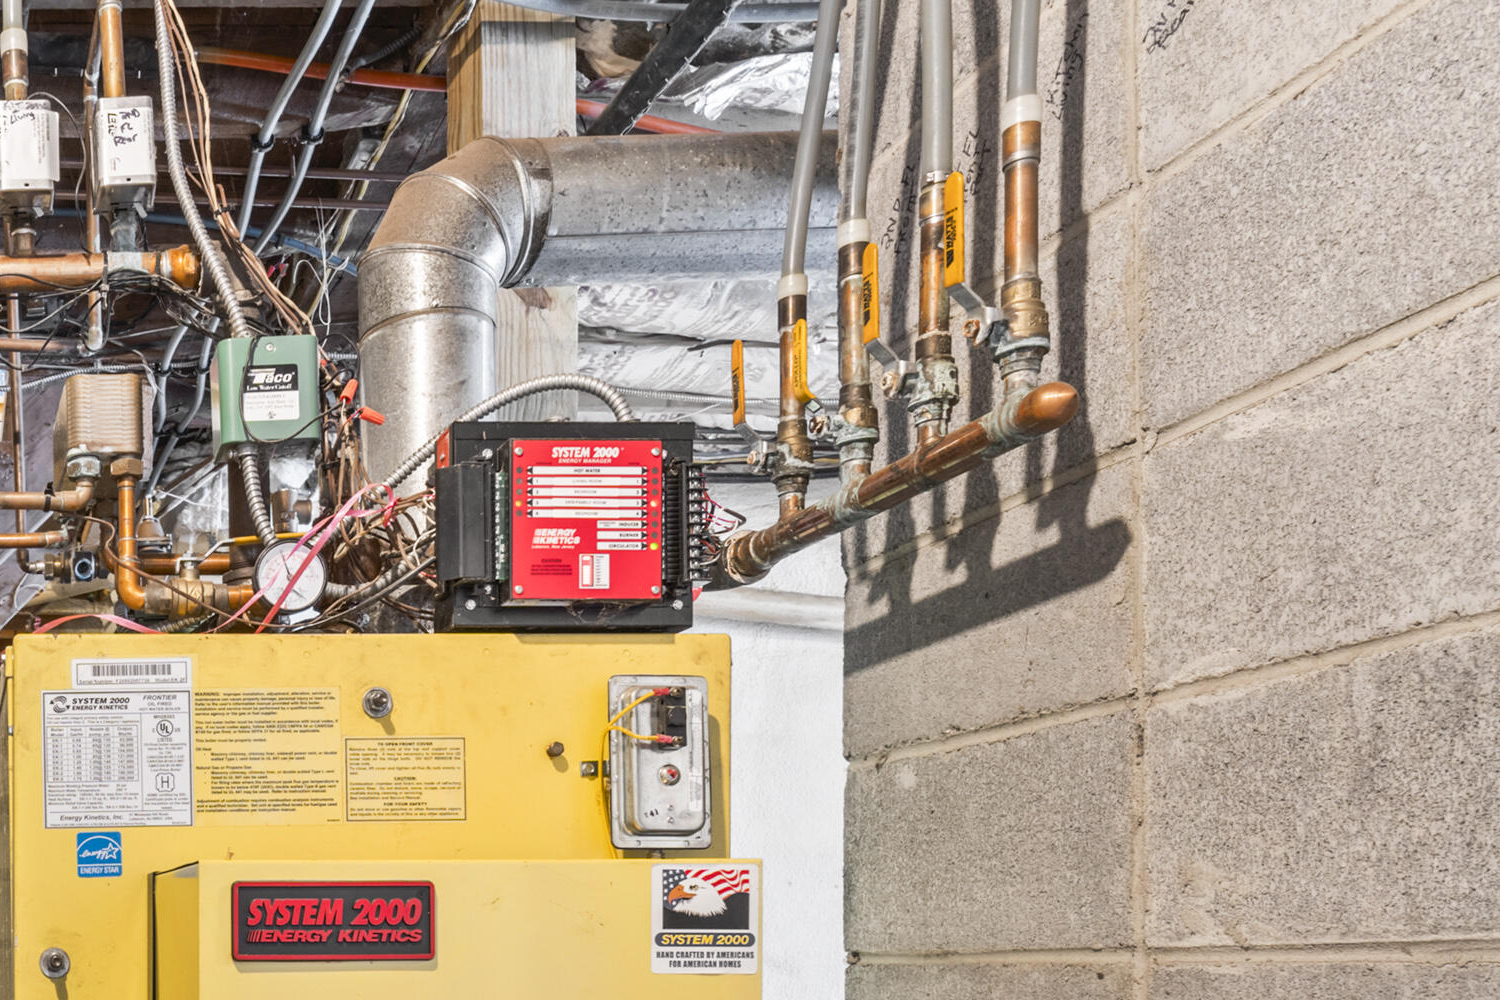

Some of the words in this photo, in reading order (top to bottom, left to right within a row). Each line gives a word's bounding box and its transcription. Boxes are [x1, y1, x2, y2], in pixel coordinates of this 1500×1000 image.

[248, 368, 292, 384] Taco
[552, 447, 590, 458] SYSTEM
[593, 447, 619, 458] 2000
[247, 898, 344, 926] SYSTEM
[350, 898, 422, 926] 2000
[260, 929, 332, 942] ENERGY
[337, 929, 423, 942] KINETICS
[661, 934, 714, 945] SYSTEM
[716, 934, 749, 945] 2000
